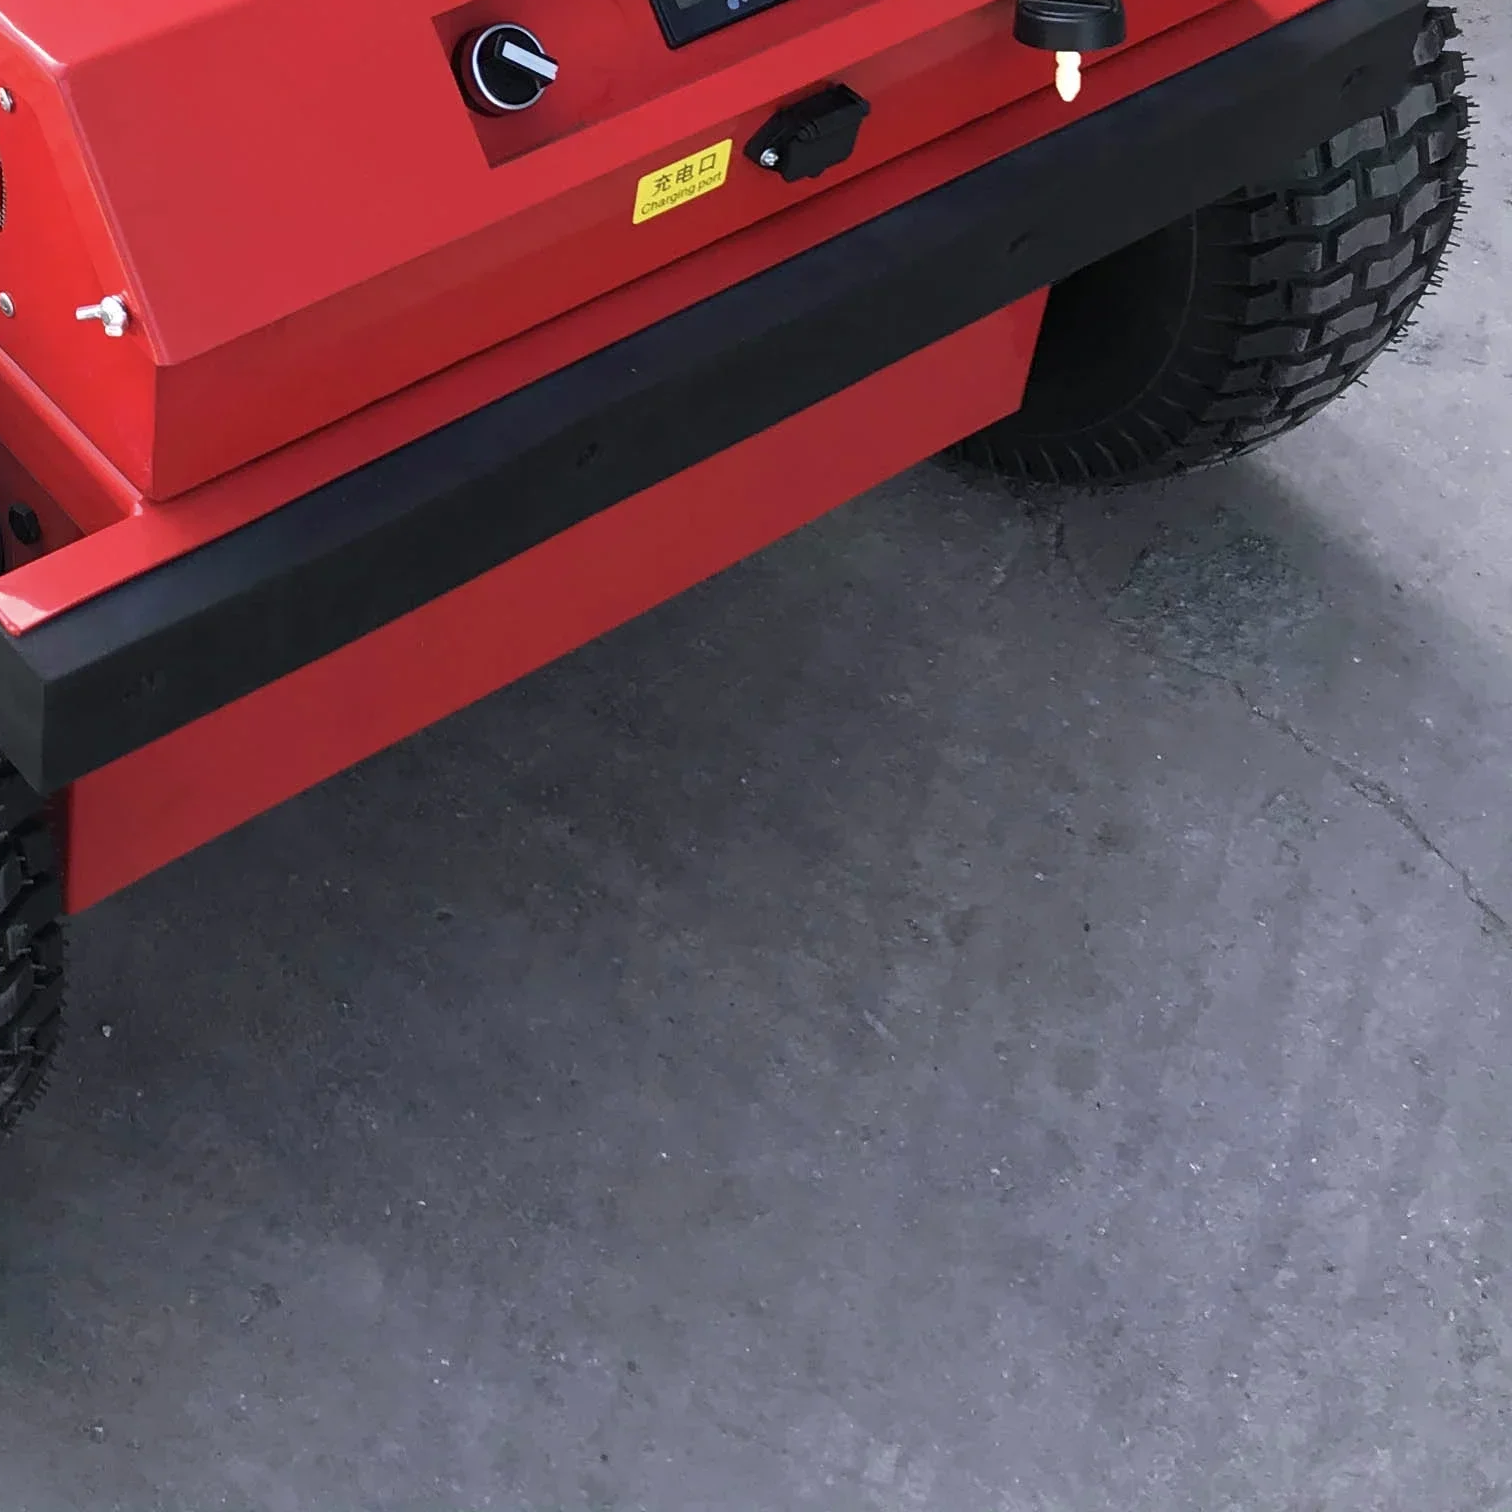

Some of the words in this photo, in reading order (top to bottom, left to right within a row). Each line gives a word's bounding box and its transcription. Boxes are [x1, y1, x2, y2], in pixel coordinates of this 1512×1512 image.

[640, 183, 697, 216] Charging
[697, 170, 723, 192] port
[651, 152, 717, 197] 充电口
